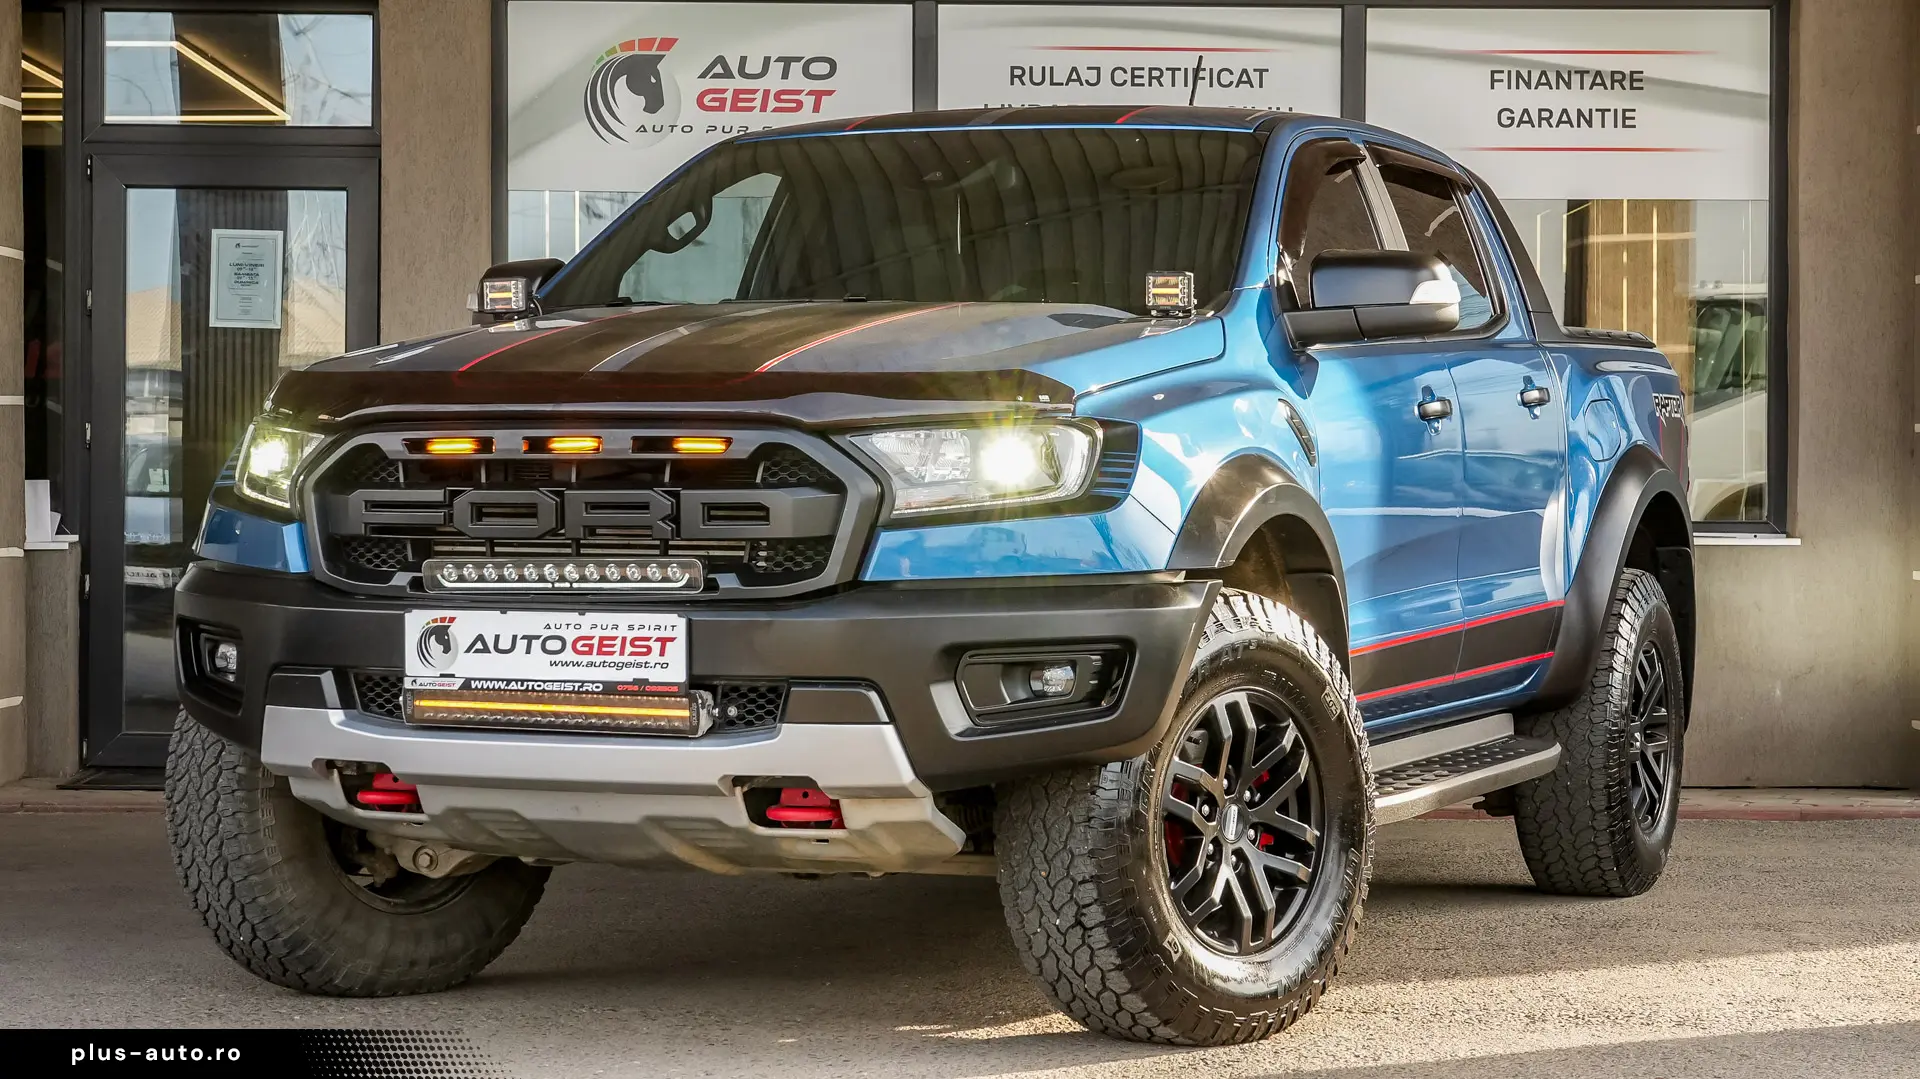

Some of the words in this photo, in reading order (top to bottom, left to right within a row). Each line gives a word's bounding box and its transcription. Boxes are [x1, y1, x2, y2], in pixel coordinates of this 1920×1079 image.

[697, 55, 838, 81] AUTO
[1009, 65, 1102, 87] RULAJ
[1110, 66, 1270, 89] CERTIFICAT
[1490, 69, 1644, 91] FINANTARE
[696, 88, 837, 113] GEIST
[635, 124, 694, 134] AUTO
[706, 124, 750, 134] PUR
[1497, 107, 1637, 129] GARANTIE
[352, 487, 785, 540] FORD
[543, 623, 582, 631] AUTO
[590, 623, 619, 631] PUR
[627, 624, 678, 632] SPIRIT
[549, 659, 670, 671] www.autogeist.ro
[470, 680, 604, 692] WWW.AUTOGEIST.RO
